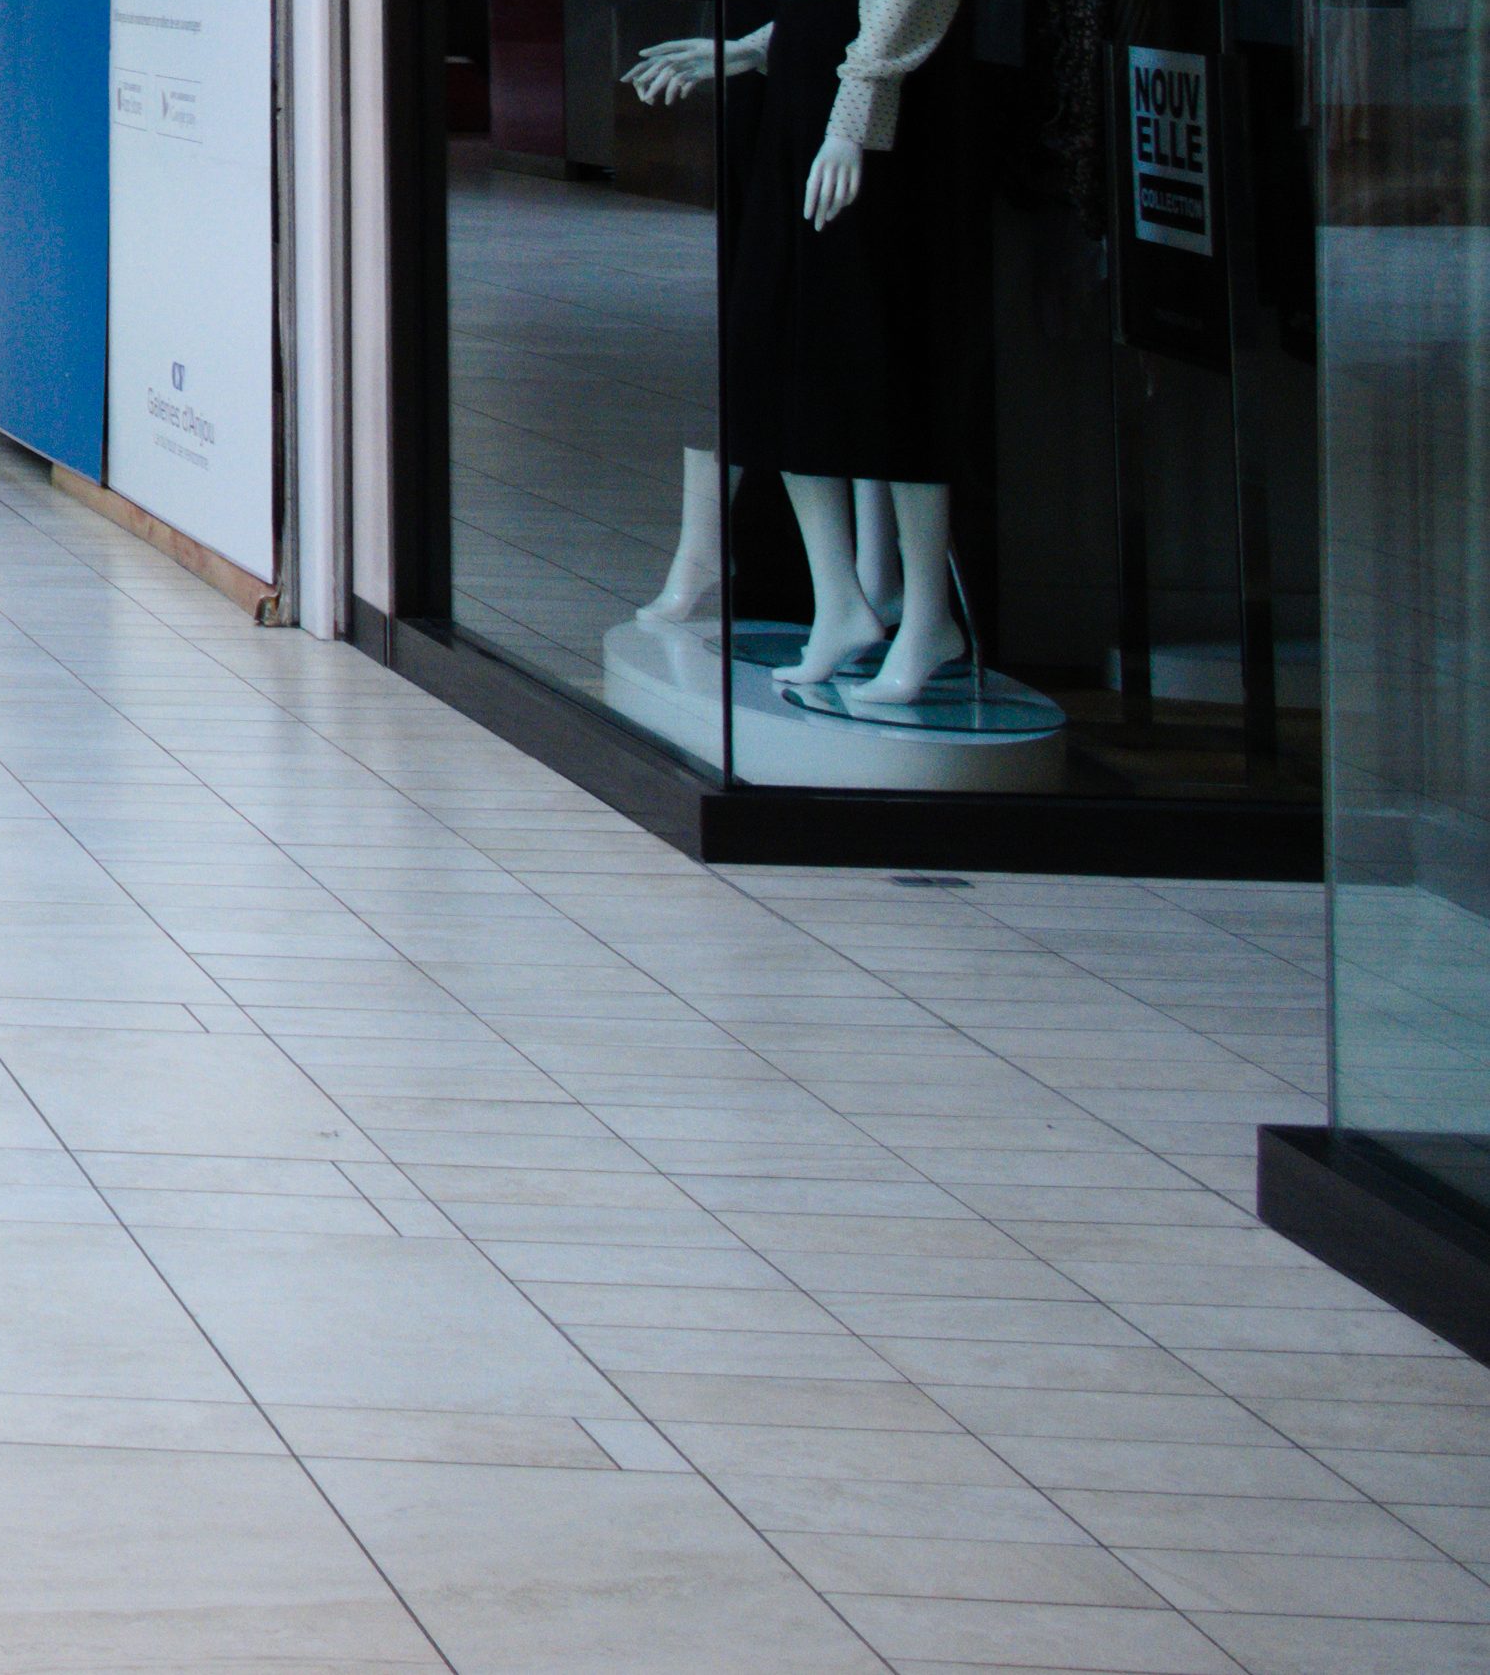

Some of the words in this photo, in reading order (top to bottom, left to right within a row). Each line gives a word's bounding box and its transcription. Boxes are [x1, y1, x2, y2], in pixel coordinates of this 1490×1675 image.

[1134, 65, 1201, 122] NOUV
[1135, 114, 1204, 175] ELLE
[1140, 186, 1204, 219] COLLECTION
[147, 386, 180, 428] Galeries
[181, 404, 215, 447] d'Anjou
